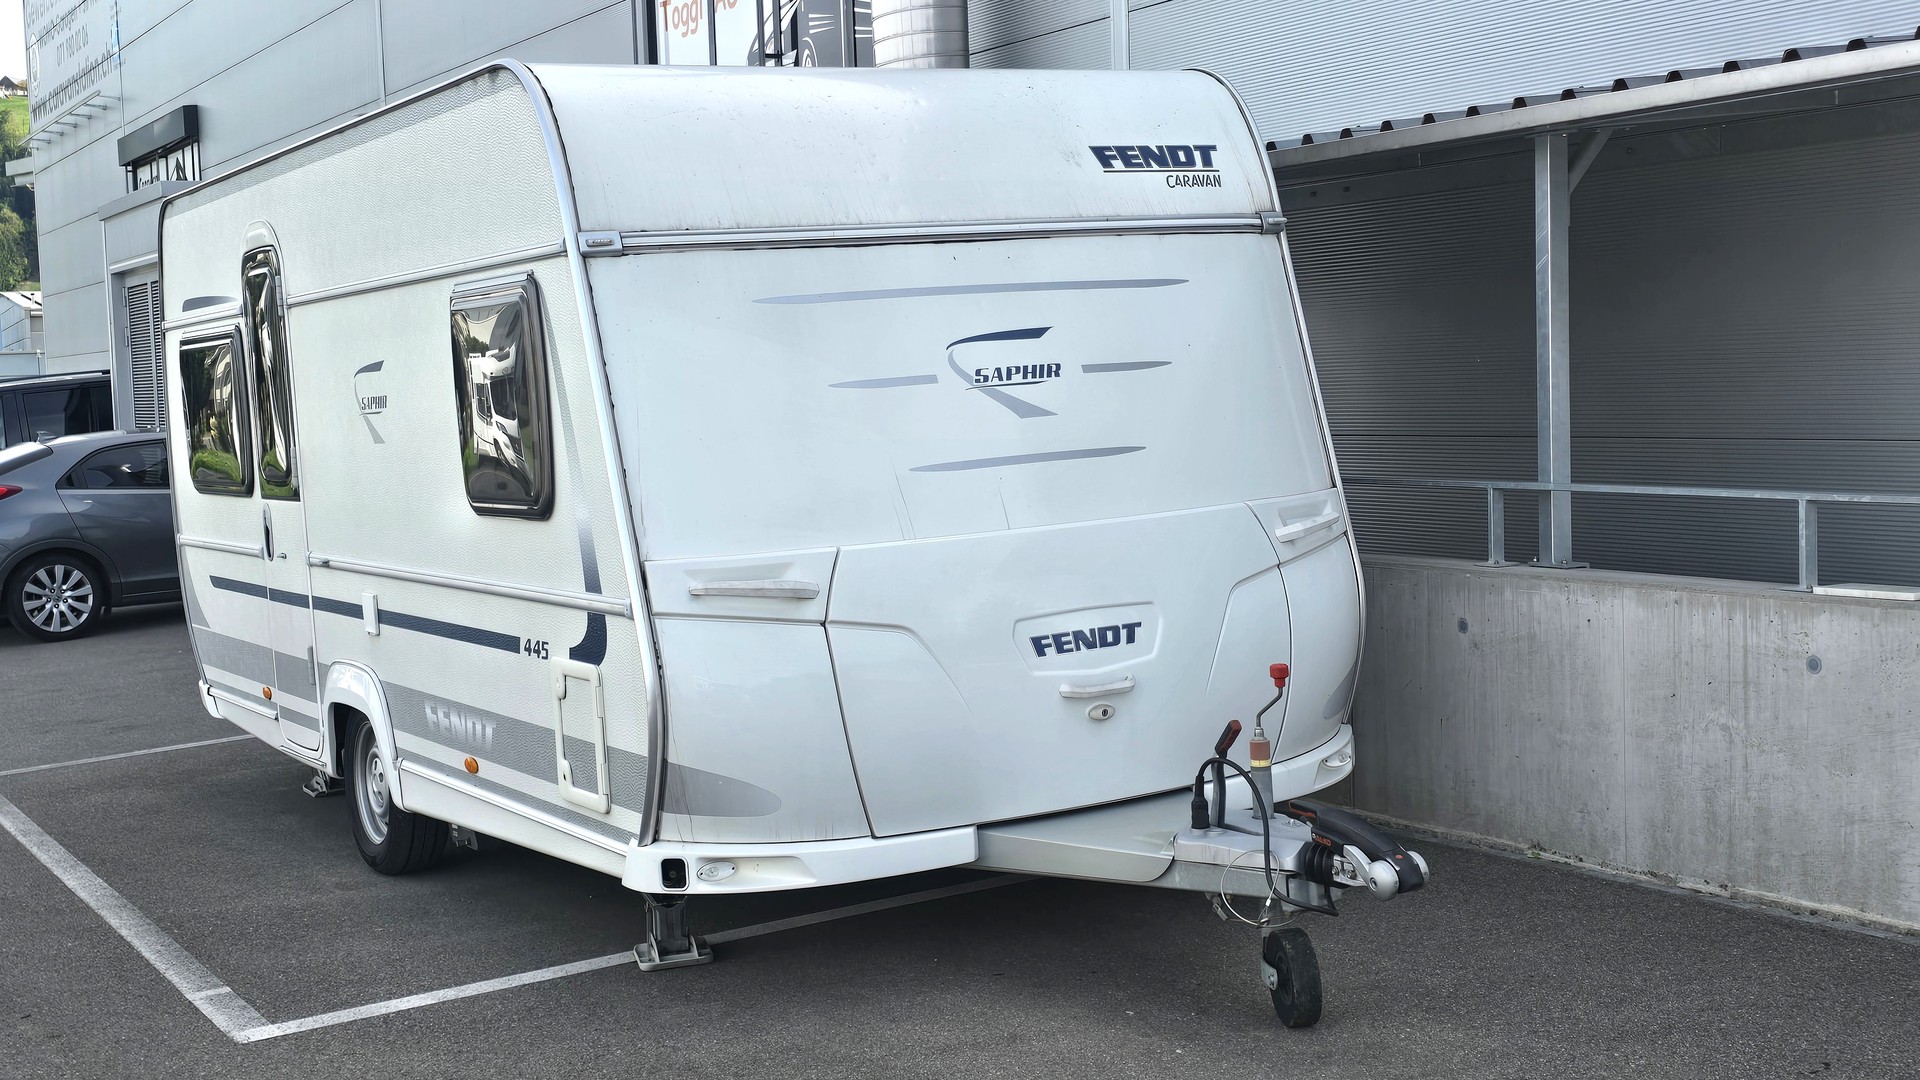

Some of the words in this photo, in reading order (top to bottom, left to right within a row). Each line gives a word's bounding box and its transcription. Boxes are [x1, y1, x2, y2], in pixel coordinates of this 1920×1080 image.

[1089, 145, 1218, 169] FENDT
[1166, 174, 1222, 189] CARAVAN
[974, 363, 1062, 384] SAPHIR
[361, 395, 387, 411] SAPHIR
[523, 638, 549, 660] 445
[1030, 622, 1142, 658] FENDT
[424, 701, 496, 750] FENDT
